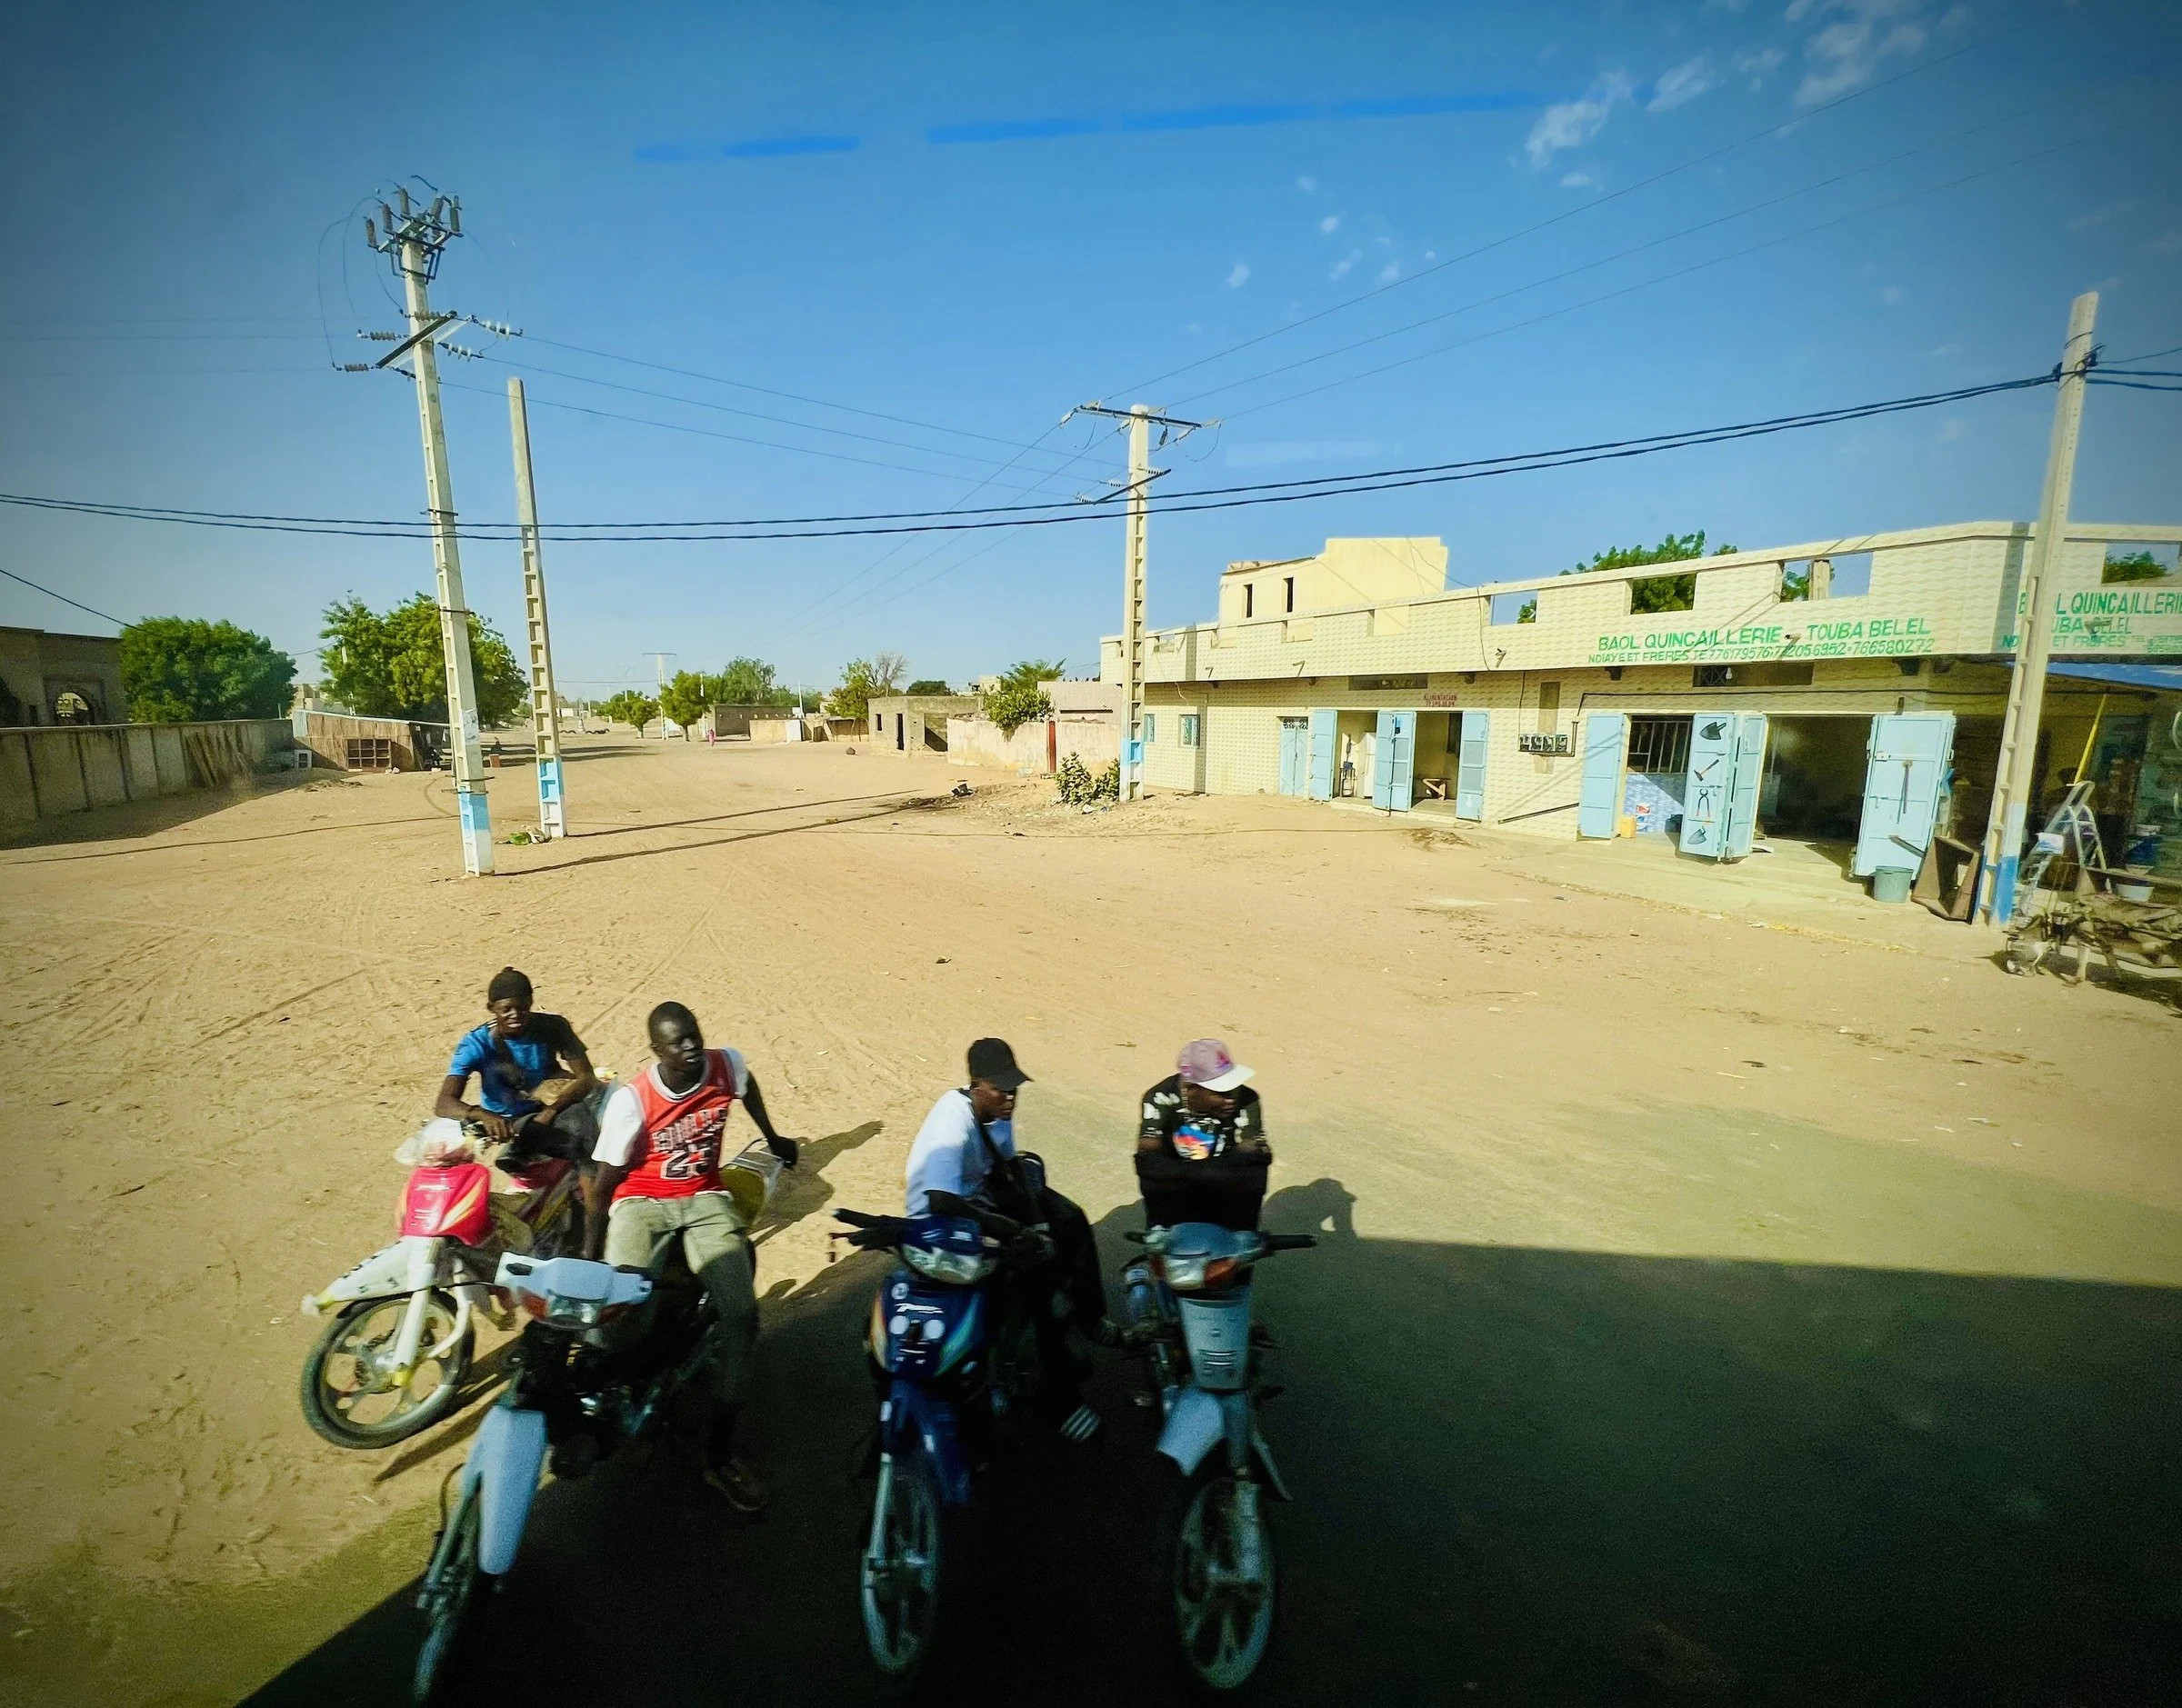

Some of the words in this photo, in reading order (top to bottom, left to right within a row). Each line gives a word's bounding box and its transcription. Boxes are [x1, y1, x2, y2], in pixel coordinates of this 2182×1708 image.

[1598, 635, 1641, 651] BAOL
[1645, 626, 1783, 648] QUINCAILLERIE
[1807, 622, 1863, 641] TOUBA
